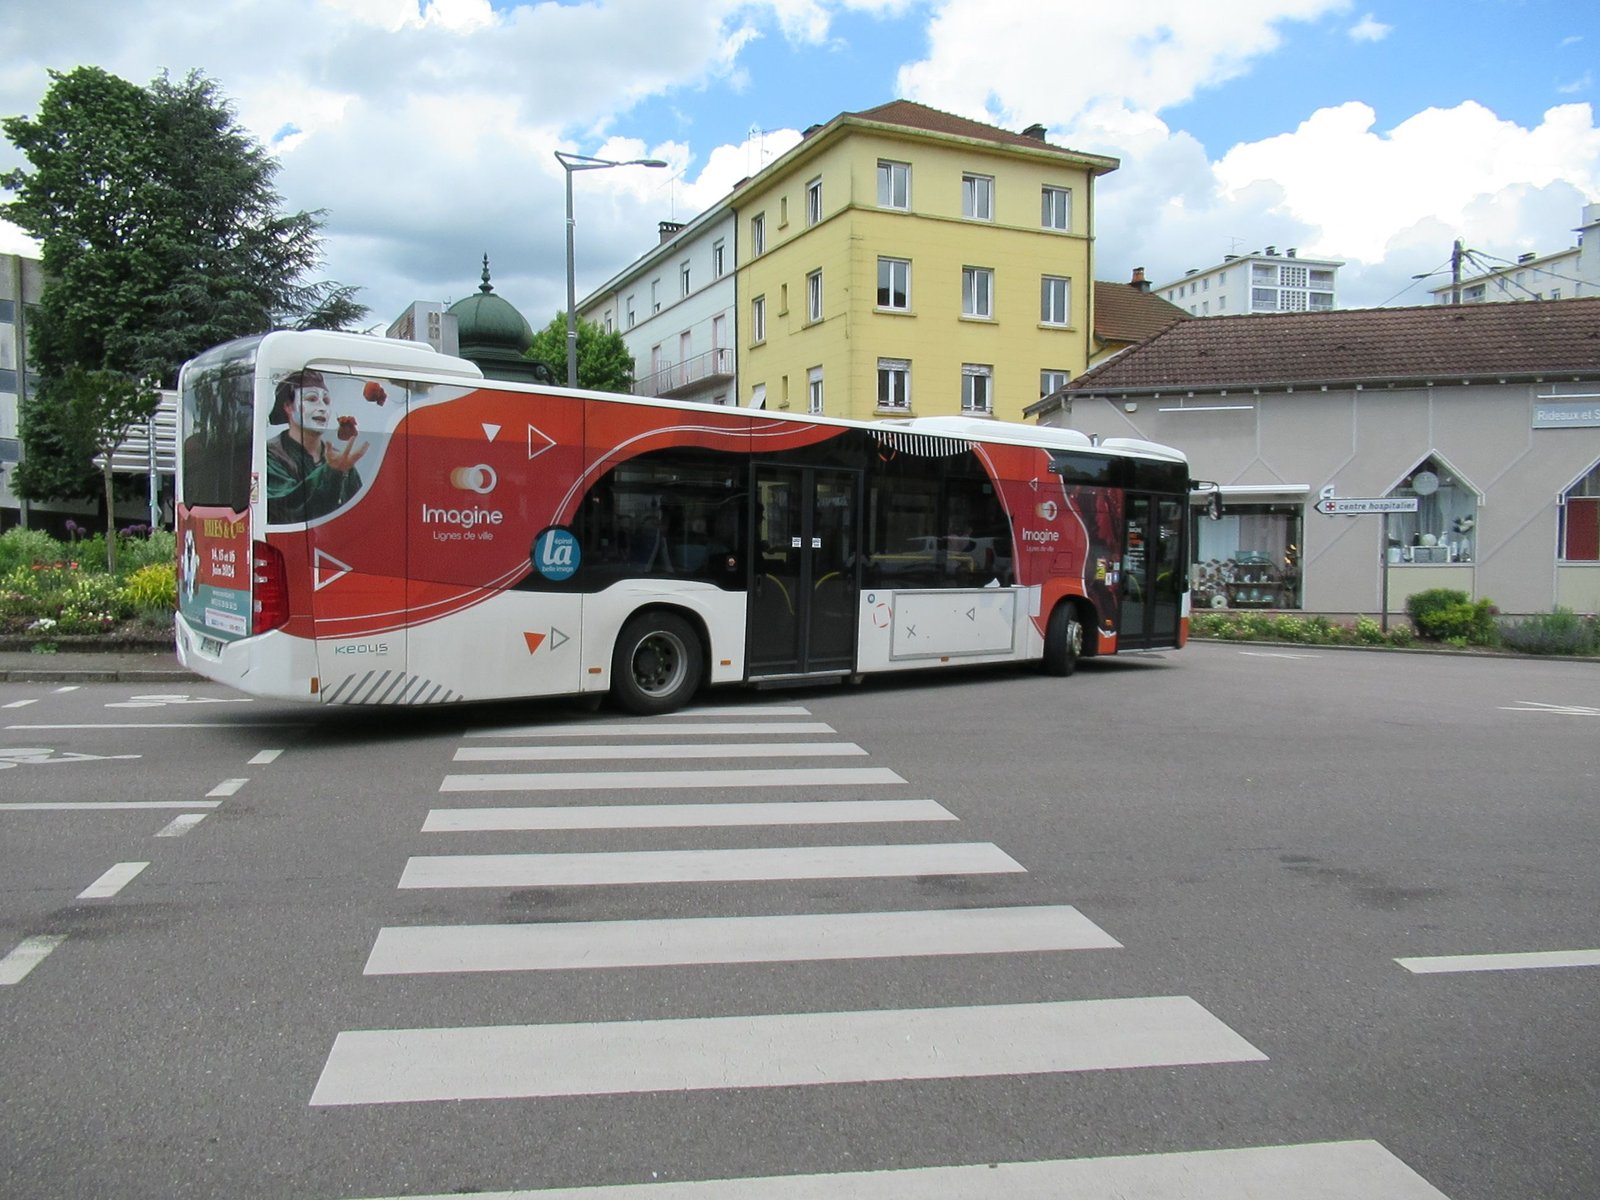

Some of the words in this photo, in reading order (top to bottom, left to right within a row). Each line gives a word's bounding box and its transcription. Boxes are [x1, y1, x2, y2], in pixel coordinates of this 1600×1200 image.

[1369, 502, 1415, 511] hospitalier
[423, 504, 503, 528] Imagine
[433, 531, 461, 542] Lignes
[463, 531, 476, 540] de
[478, 531, 493, 540] ville
[1022, 527, 1060, 544] Imagine
[543, 530, 572, 565] la
